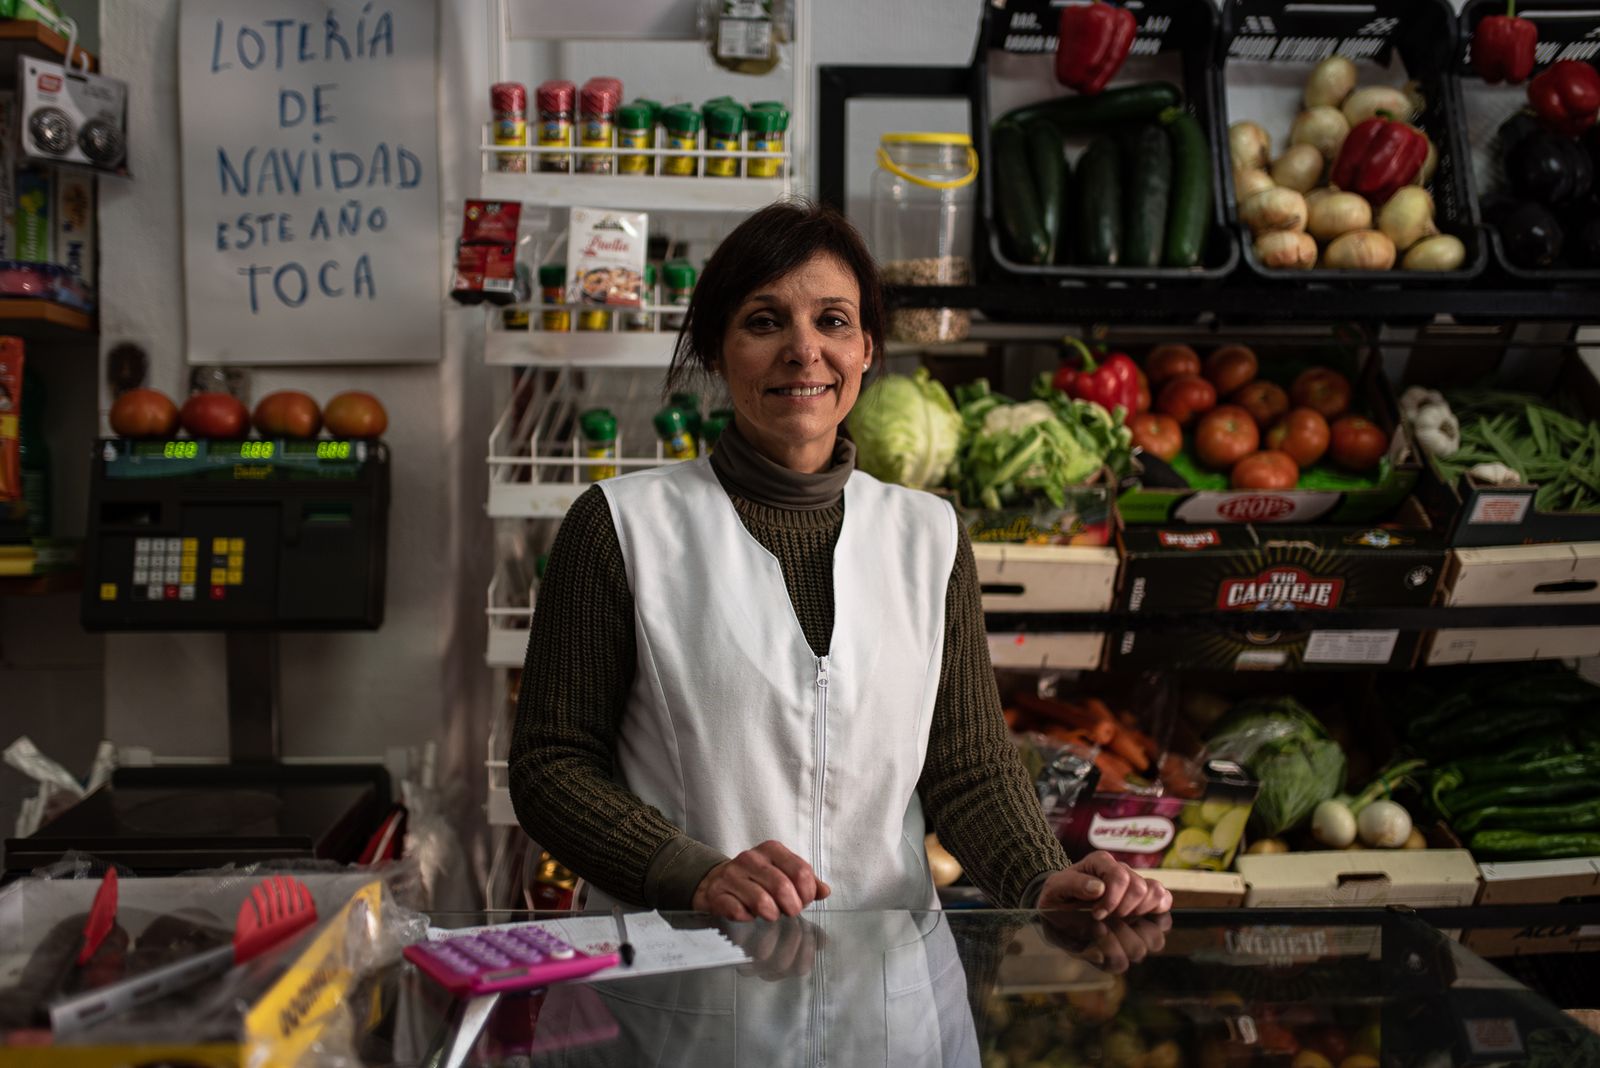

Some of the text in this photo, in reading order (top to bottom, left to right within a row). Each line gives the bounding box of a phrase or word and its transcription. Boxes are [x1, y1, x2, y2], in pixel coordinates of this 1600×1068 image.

[210, 2, 395, 73] LOTERÍA
[278, 84, 338, 128] DE
[216, 133, 423, 196] NAVIDAD
[216, 199, 388, 251] ESTE AÑO
[237, 252, 376, 314] TOCA
[1226, 581, 1333, 606] CACHEJE
